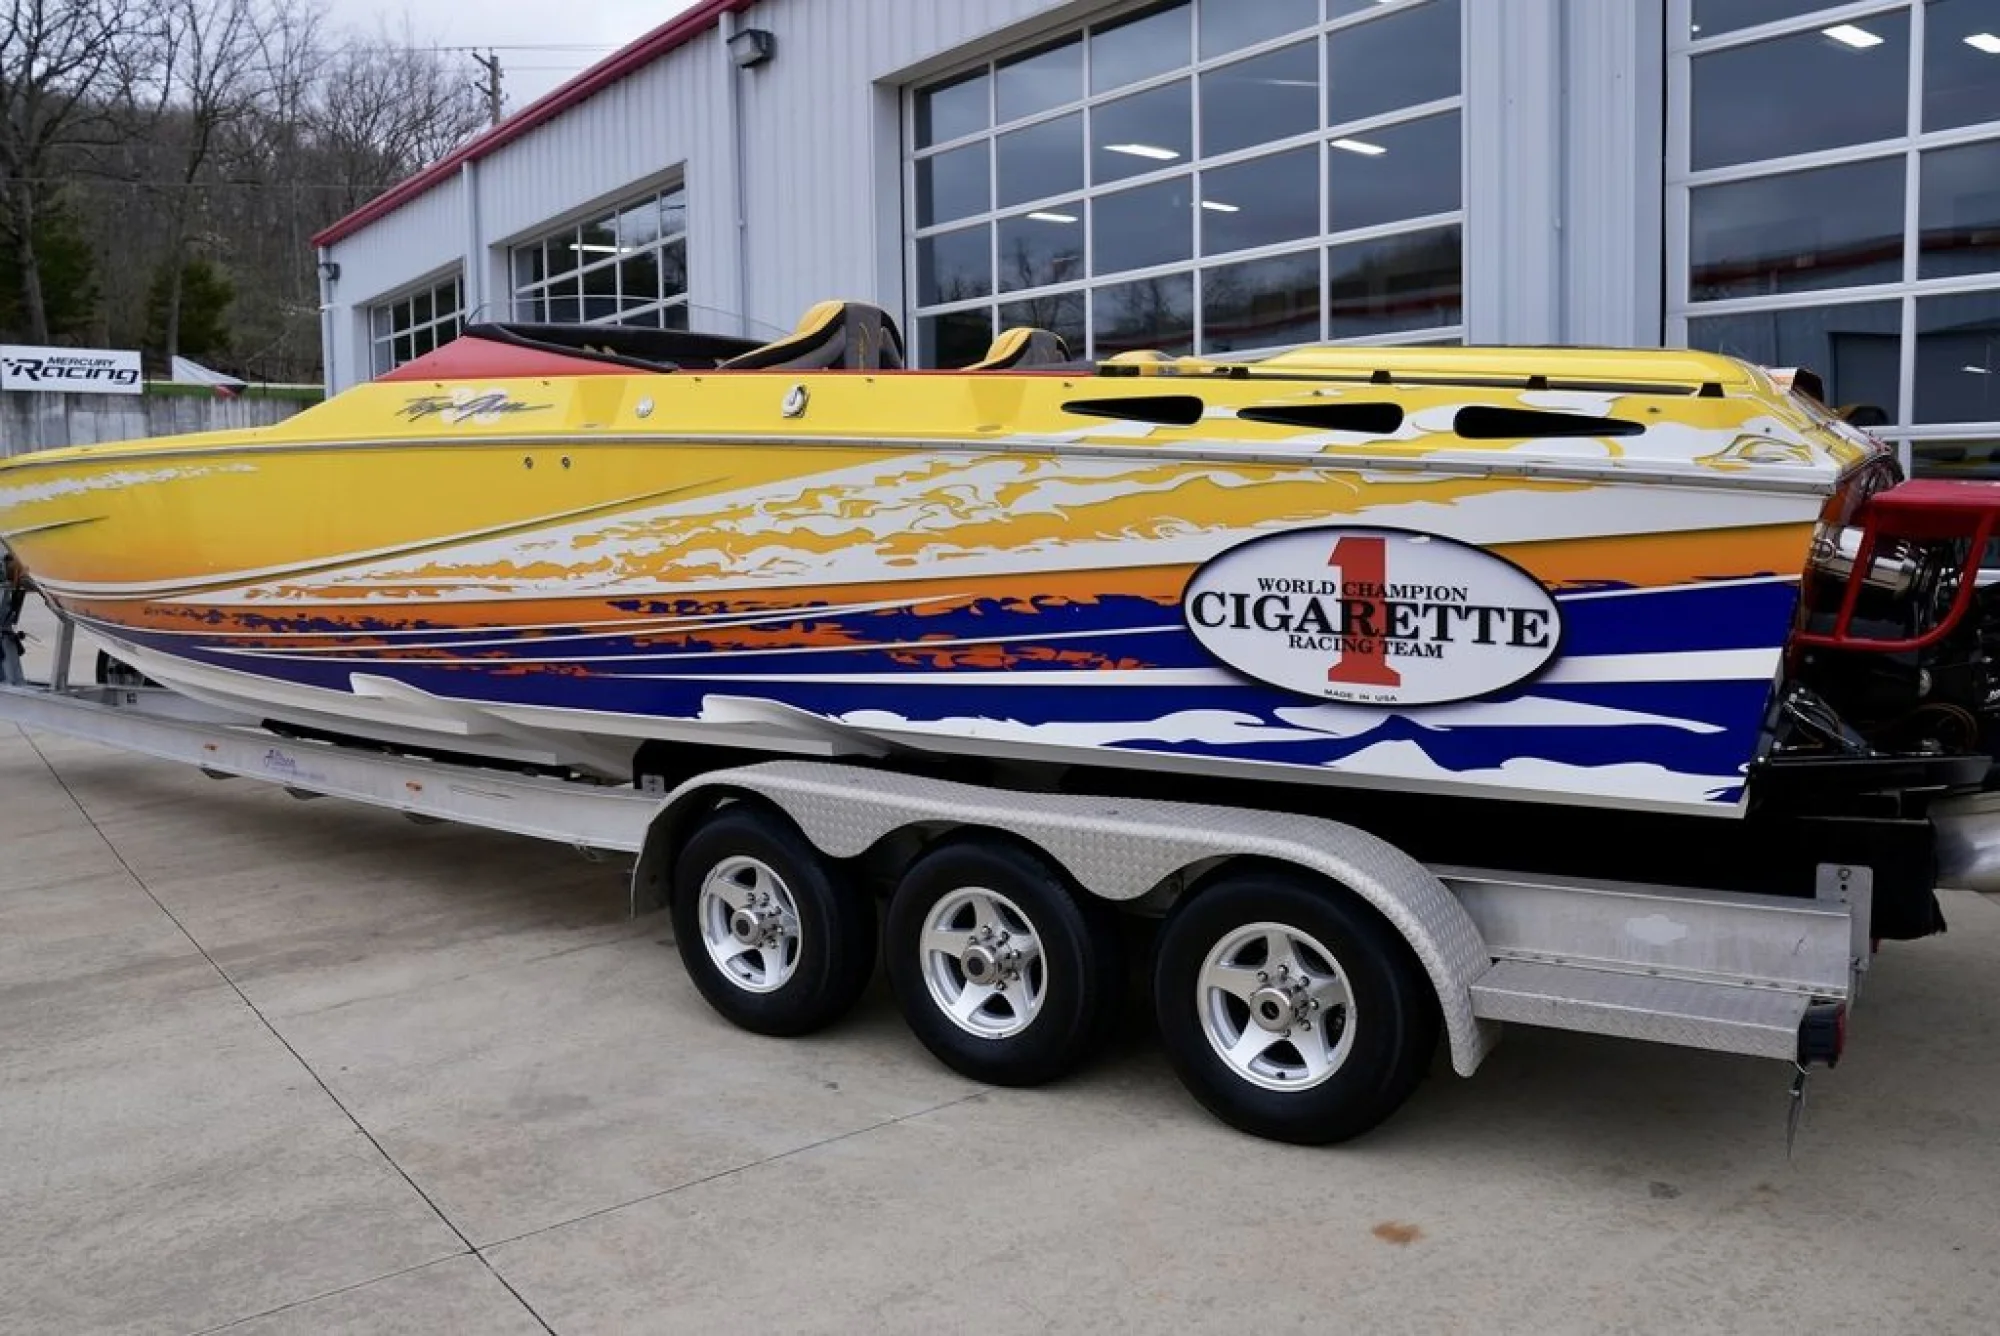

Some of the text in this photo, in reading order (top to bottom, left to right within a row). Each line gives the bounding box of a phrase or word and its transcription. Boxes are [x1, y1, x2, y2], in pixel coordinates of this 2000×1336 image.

[4, 358, 139, 385] Racing
[47, 357, 115, 367] MERCURY
[1257, 577, 1468, 602] WORLD CHAMPION
[1191, 591, 1549, 649] CIGARETTE
[1328, 536, 1401, 687] 1
[1288, 634, 1444, 659] RACING TEAM
[1323, 688, 1353, 698] MADE
